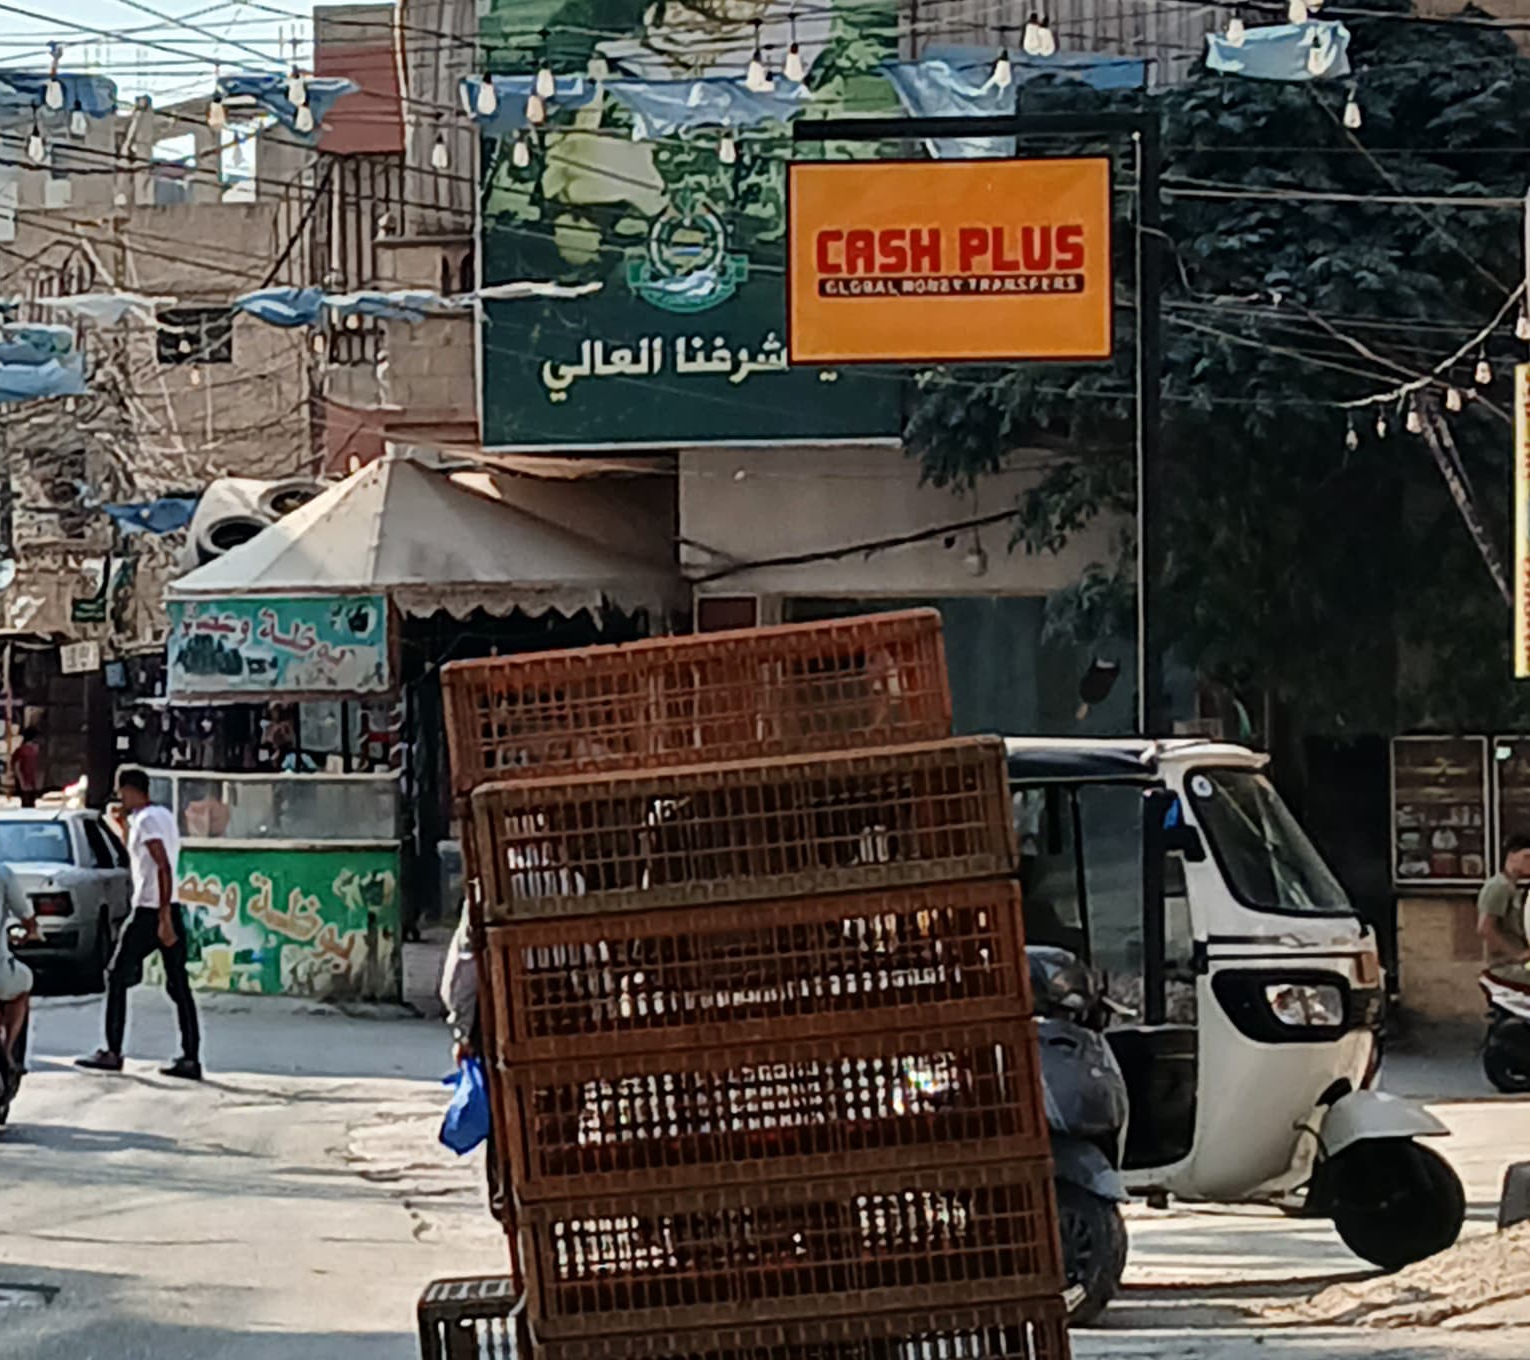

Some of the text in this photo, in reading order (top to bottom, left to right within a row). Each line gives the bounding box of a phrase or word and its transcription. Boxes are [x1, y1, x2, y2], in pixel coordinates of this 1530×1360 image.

[816, 225, 1084, 274] CASH PLUS
[824, 279, 898, 295] GLOBAL
[969, 276, 1078, 292] TRANSFERS
[542, 336, 662, 402] العالي
